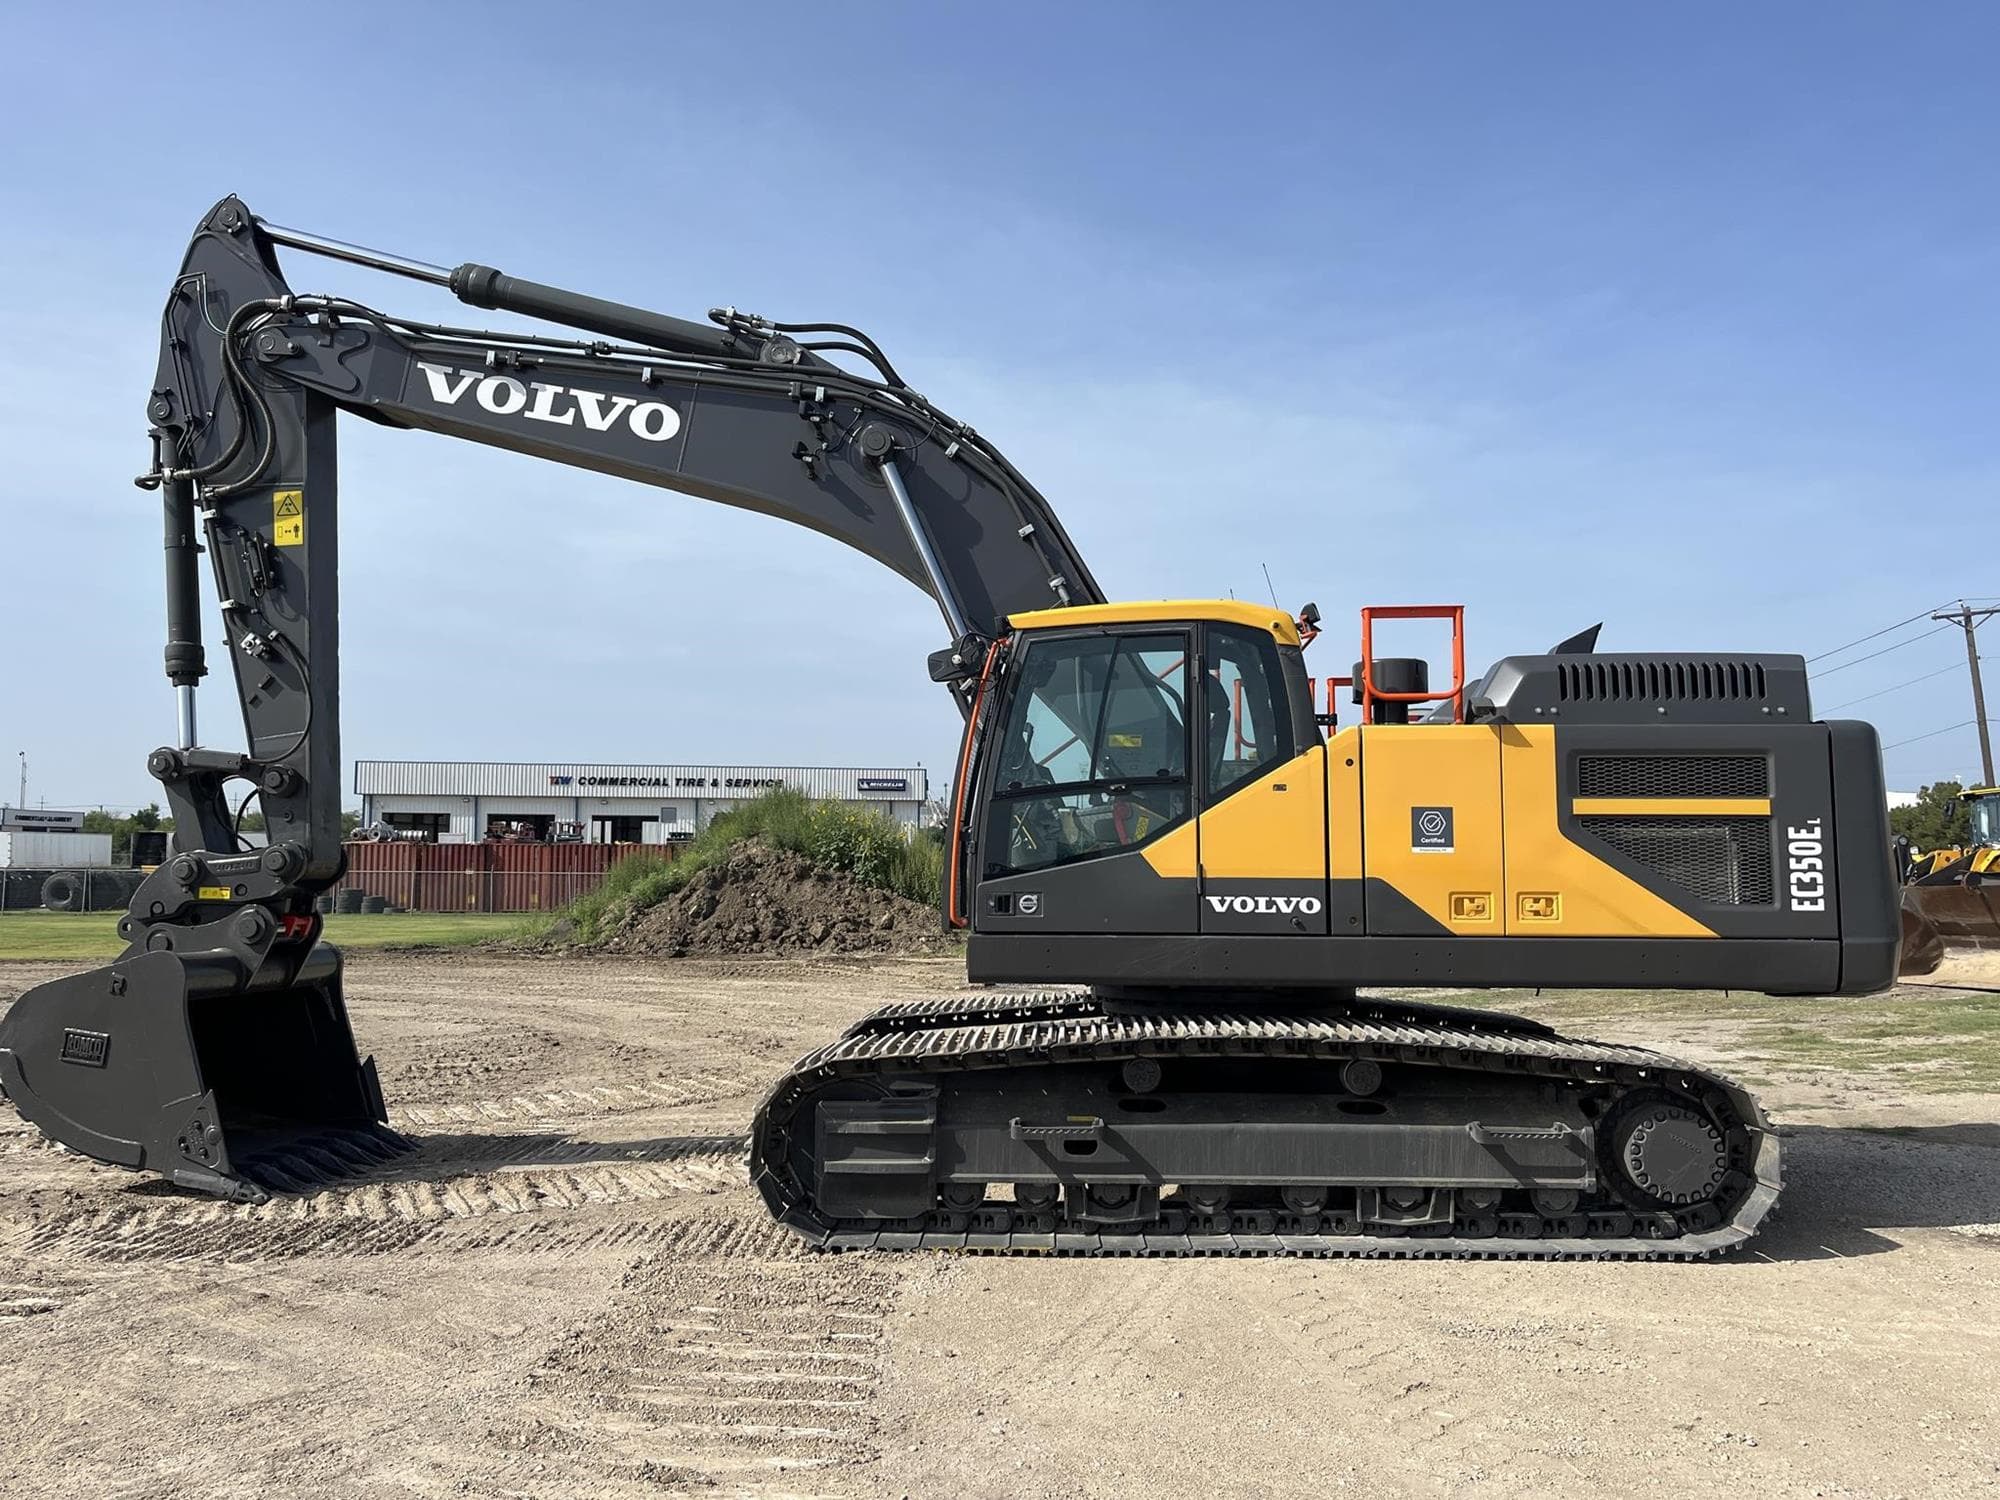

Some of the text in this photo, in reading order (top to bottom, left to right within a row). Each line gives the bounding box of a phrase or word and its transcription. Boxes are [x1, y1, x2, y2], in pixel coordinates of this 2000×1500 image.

[417, 361, 681, 442] VOLVO
[578, 776, 669, 788] COMMERCIAL
[675, 777, 706, 788] TIRE
[710, 778, 719, 788] &
[725, 778, 784, 788] SERVICE
[1205, 896, 1321, 914] VOLVO
